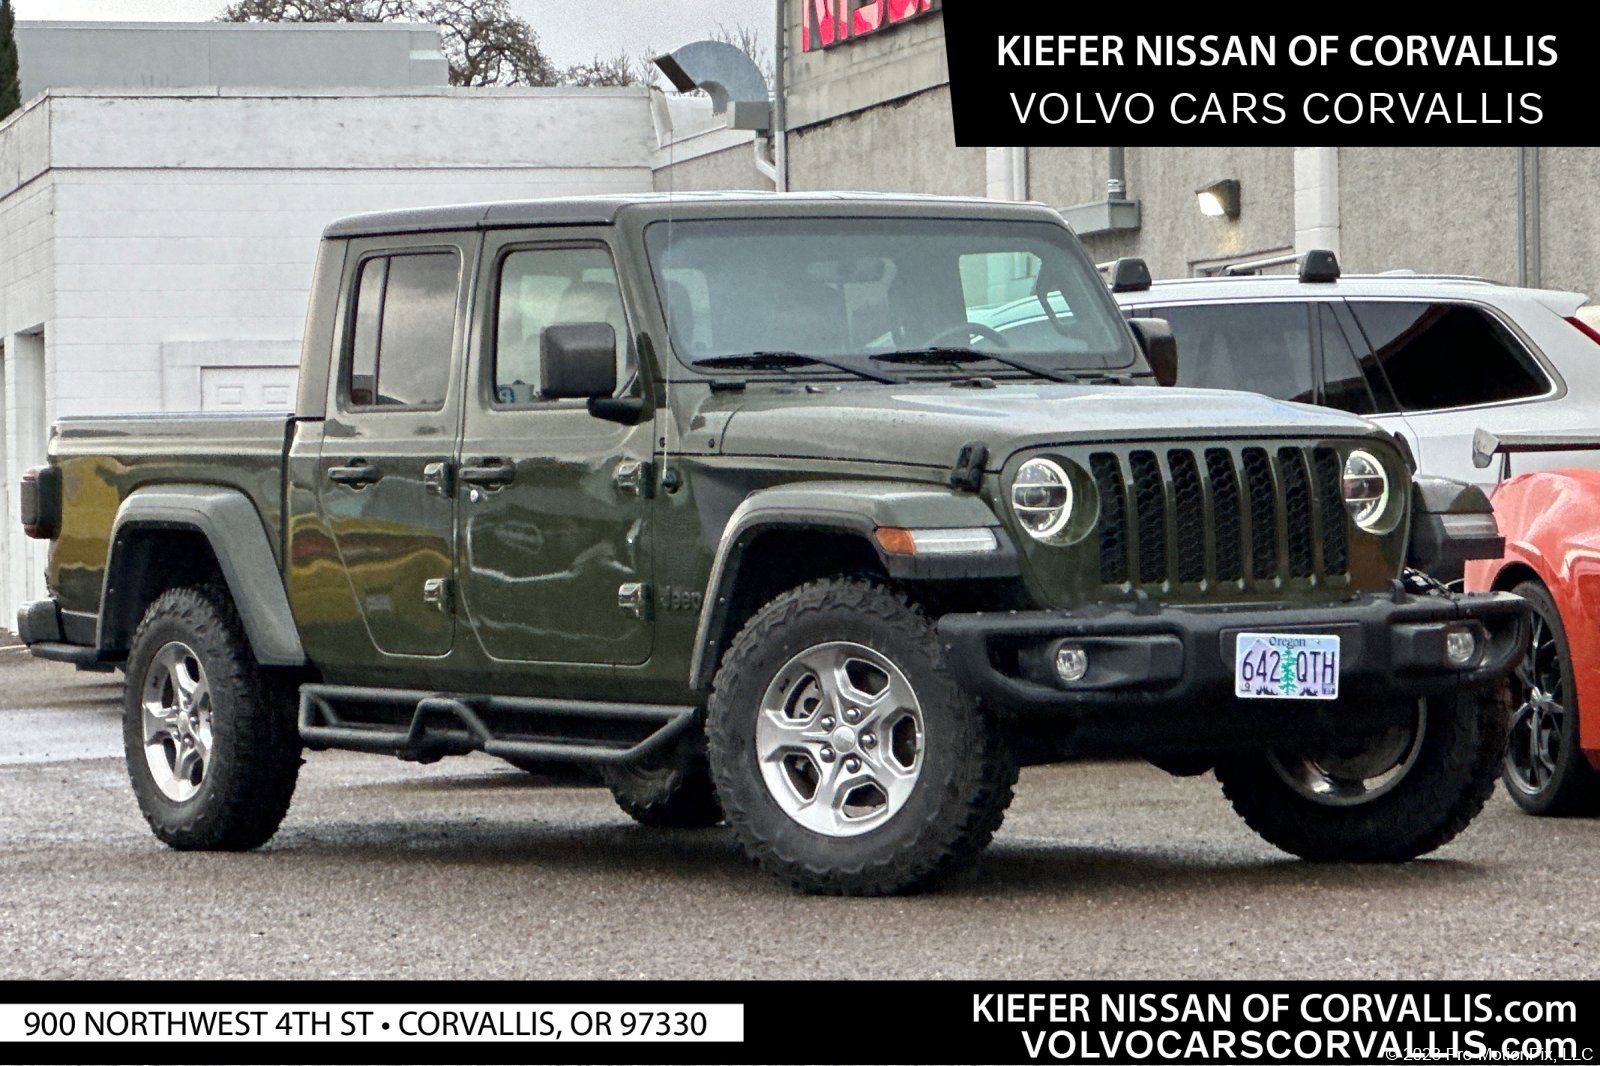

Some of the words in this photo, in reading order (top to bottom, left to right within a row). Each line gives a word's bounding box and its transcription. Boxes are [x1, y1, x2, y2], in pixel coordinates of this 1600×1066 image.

[1269, 636, 1307, 649] Oregon
[1242, 650, 1281, 682] 642
[1296, 651, 1335, 684] QTH
